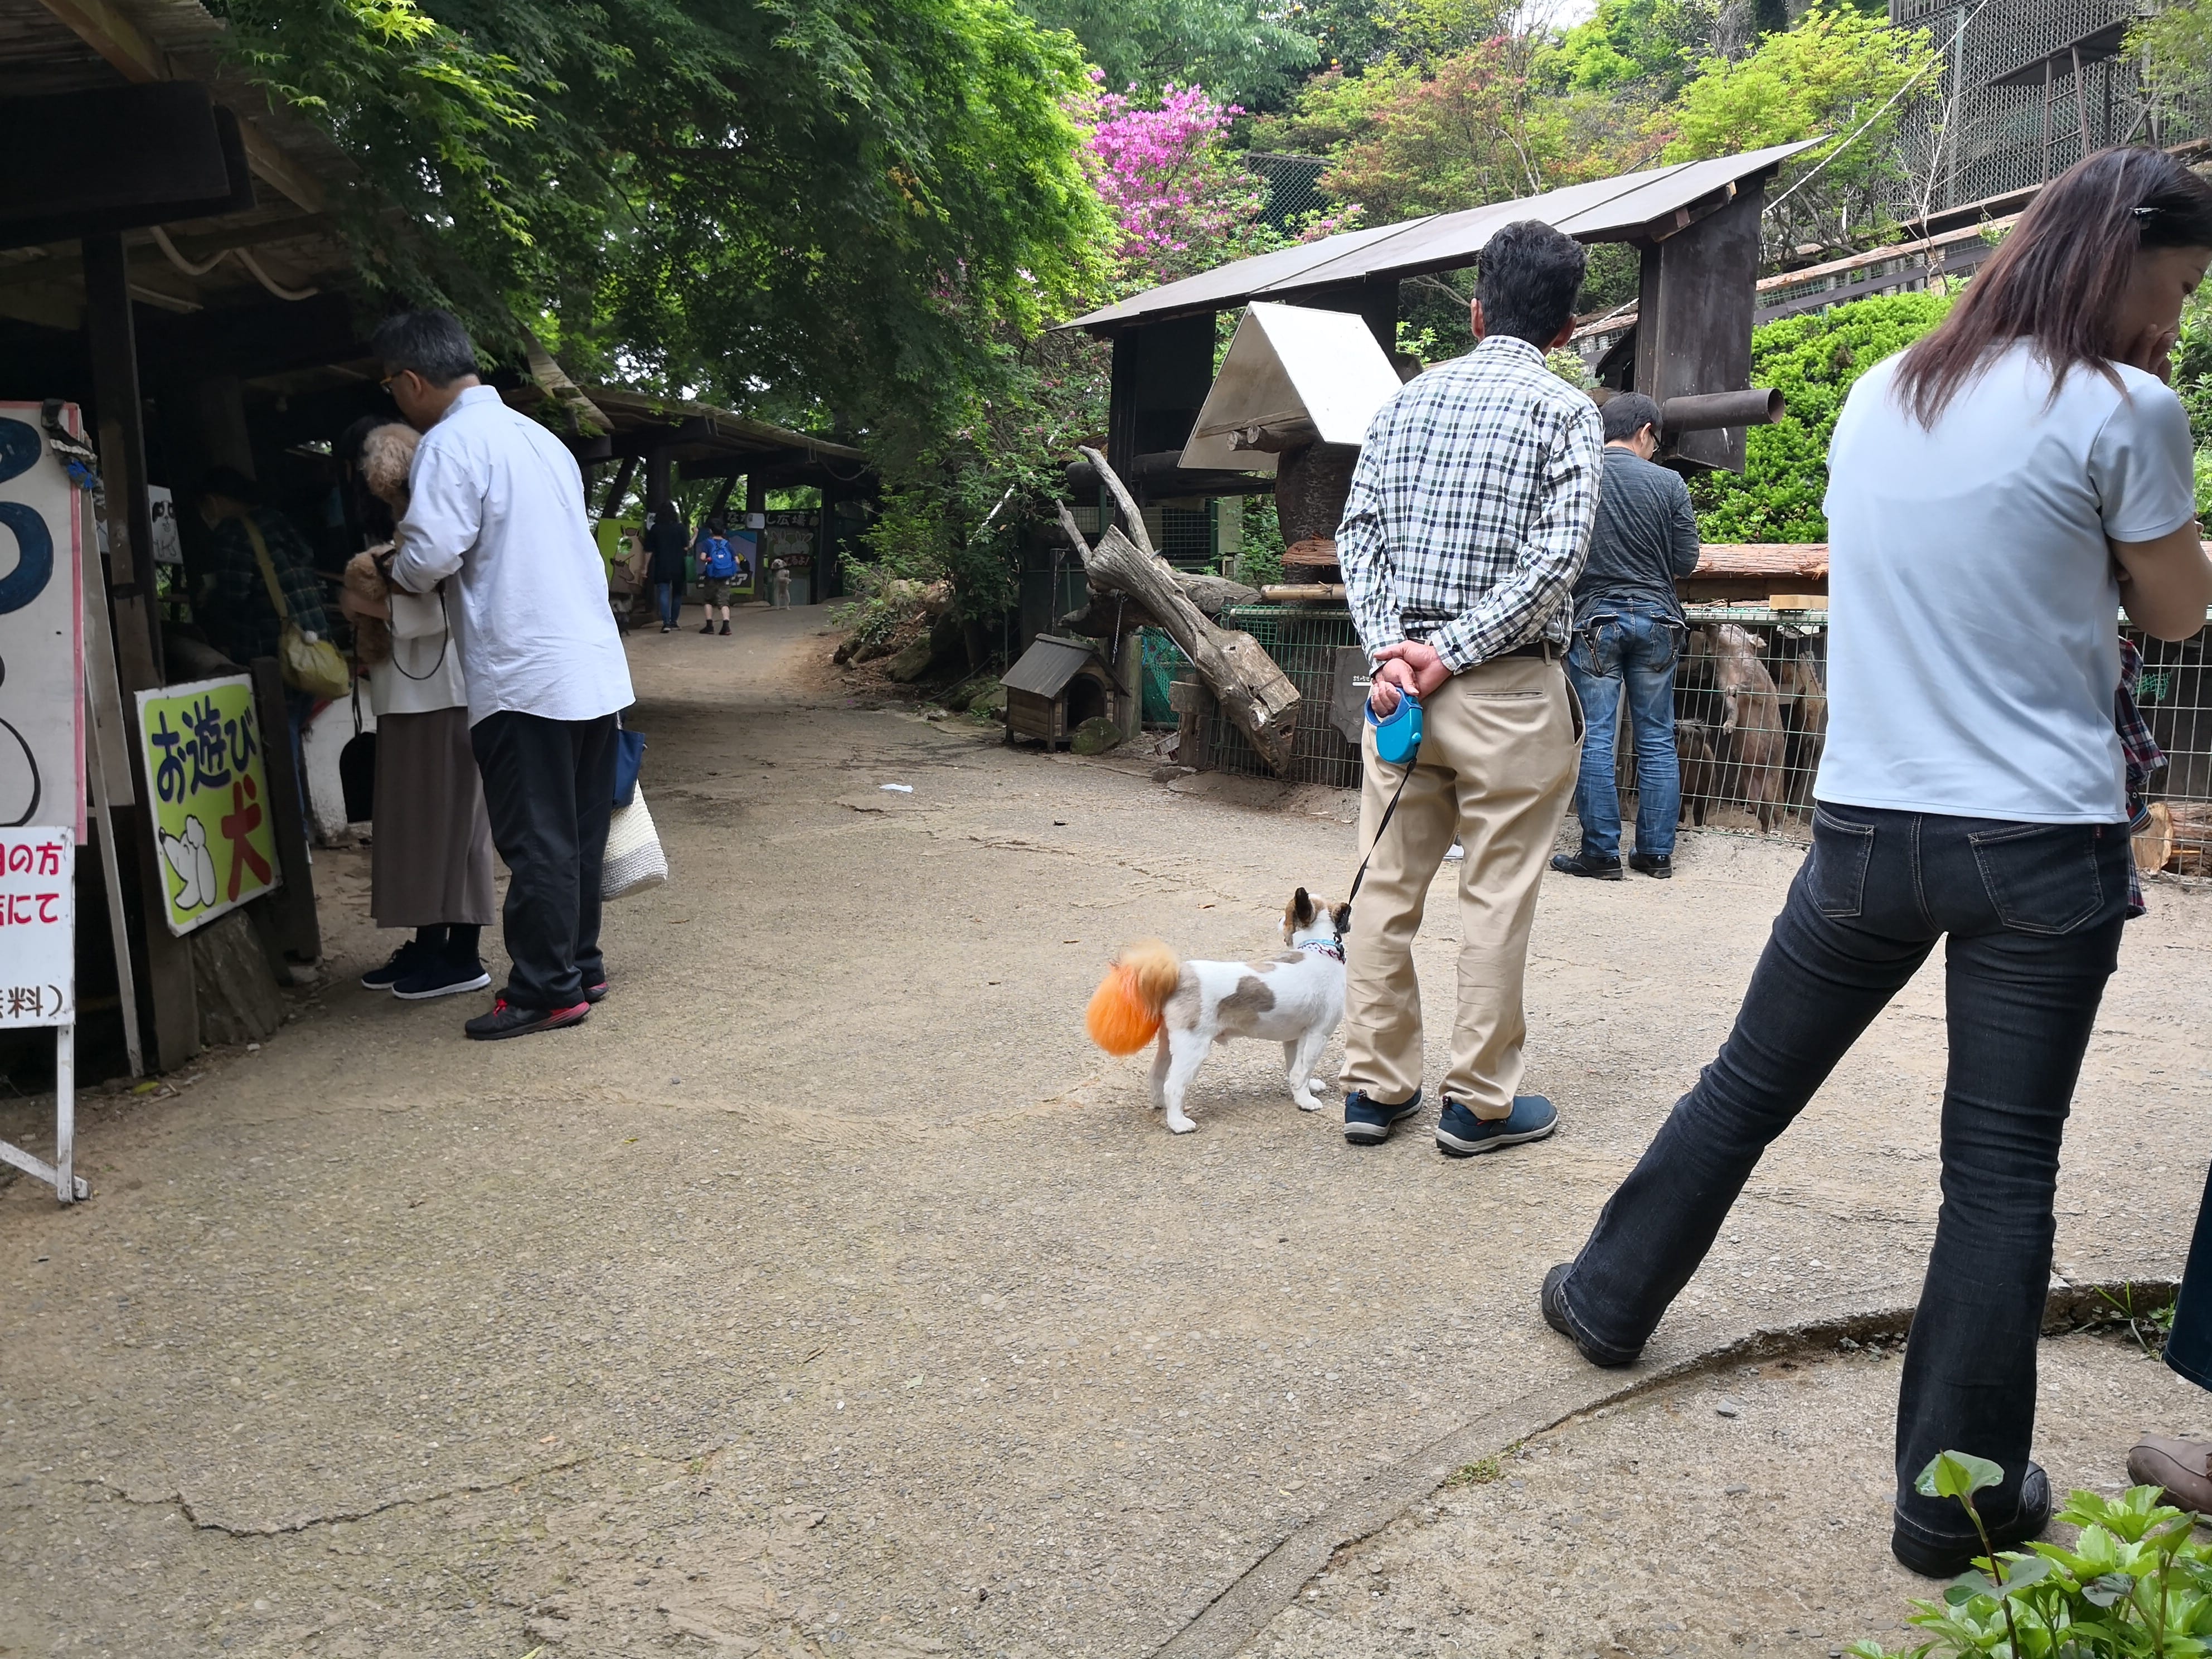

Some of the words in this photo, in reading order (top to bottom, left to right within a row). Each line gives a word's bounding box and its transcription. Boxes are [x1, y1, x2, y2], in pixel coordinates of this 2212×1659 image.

[727, 511, 806, 526] なし広場
[152, 695, 257, 804] お遊び
[221, 773, 272, 902] 犬
[0, 842, 63, 876] の方
[0, 893, 59, 926] にて
[0, 984, 62, 1019] 料)
